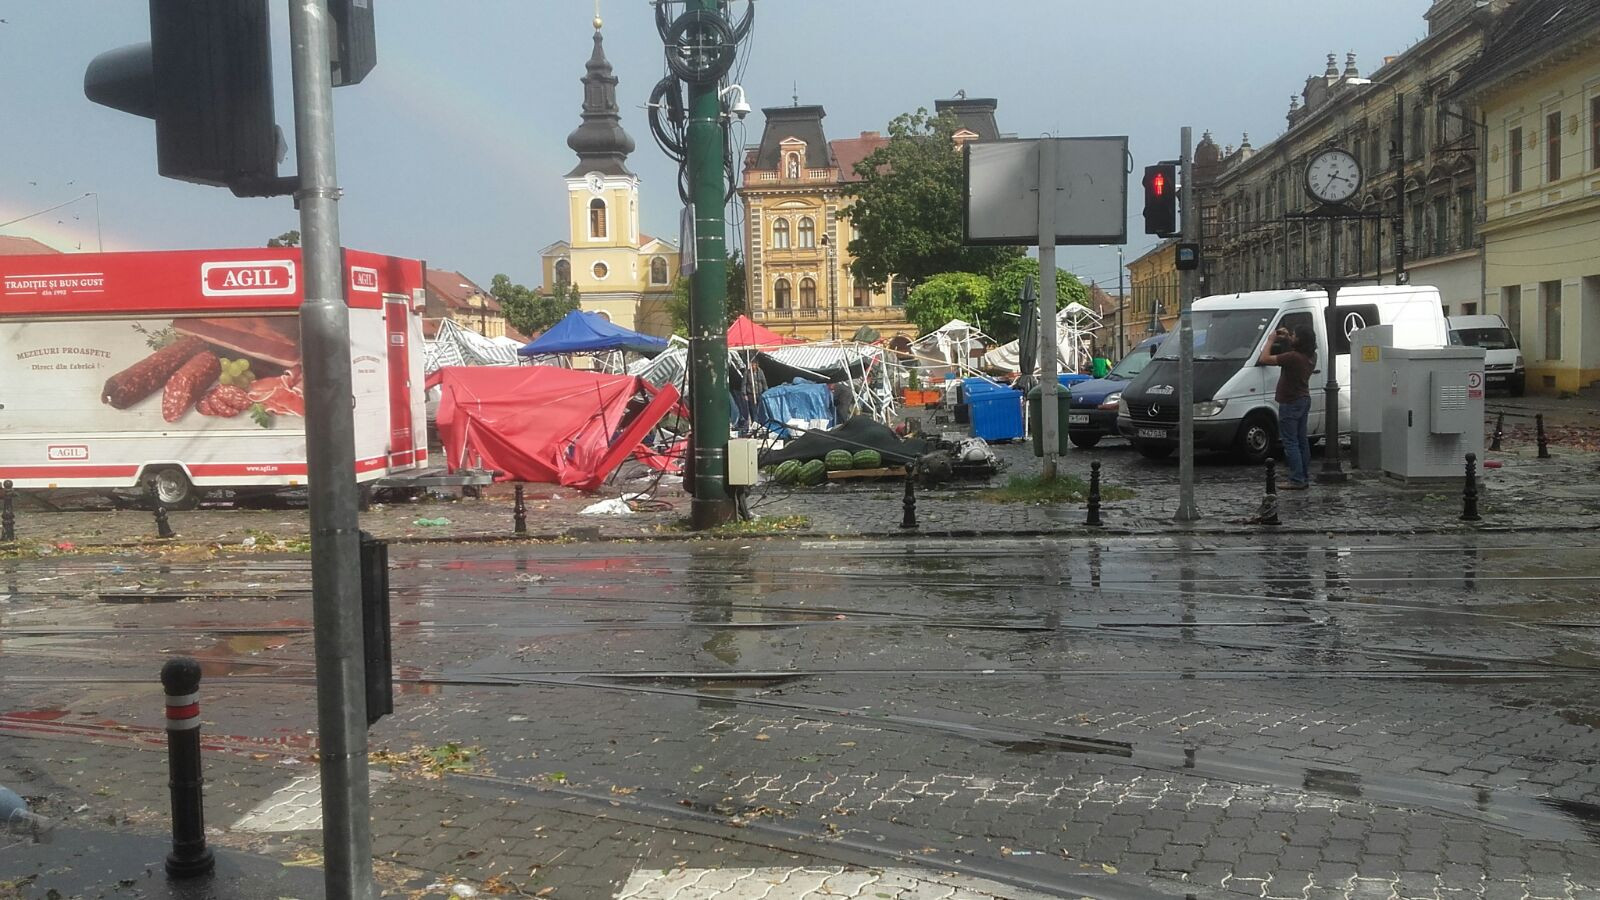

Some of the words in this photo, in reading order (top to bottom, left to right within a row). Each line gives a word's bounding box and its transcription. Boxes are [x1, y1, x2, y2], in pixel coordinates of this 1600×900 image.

[59, 279, 79, 287] BUN
[80, 278, 104, 287] GUST
[222, 269, 278, 287] AGIL
[357, 272, 374, 286] AGIL
[16, 347, 60, 360] MEZELURI
[62, 347, 111, 358] PROASPETE
[56, 448, 82, 457] AGIL
